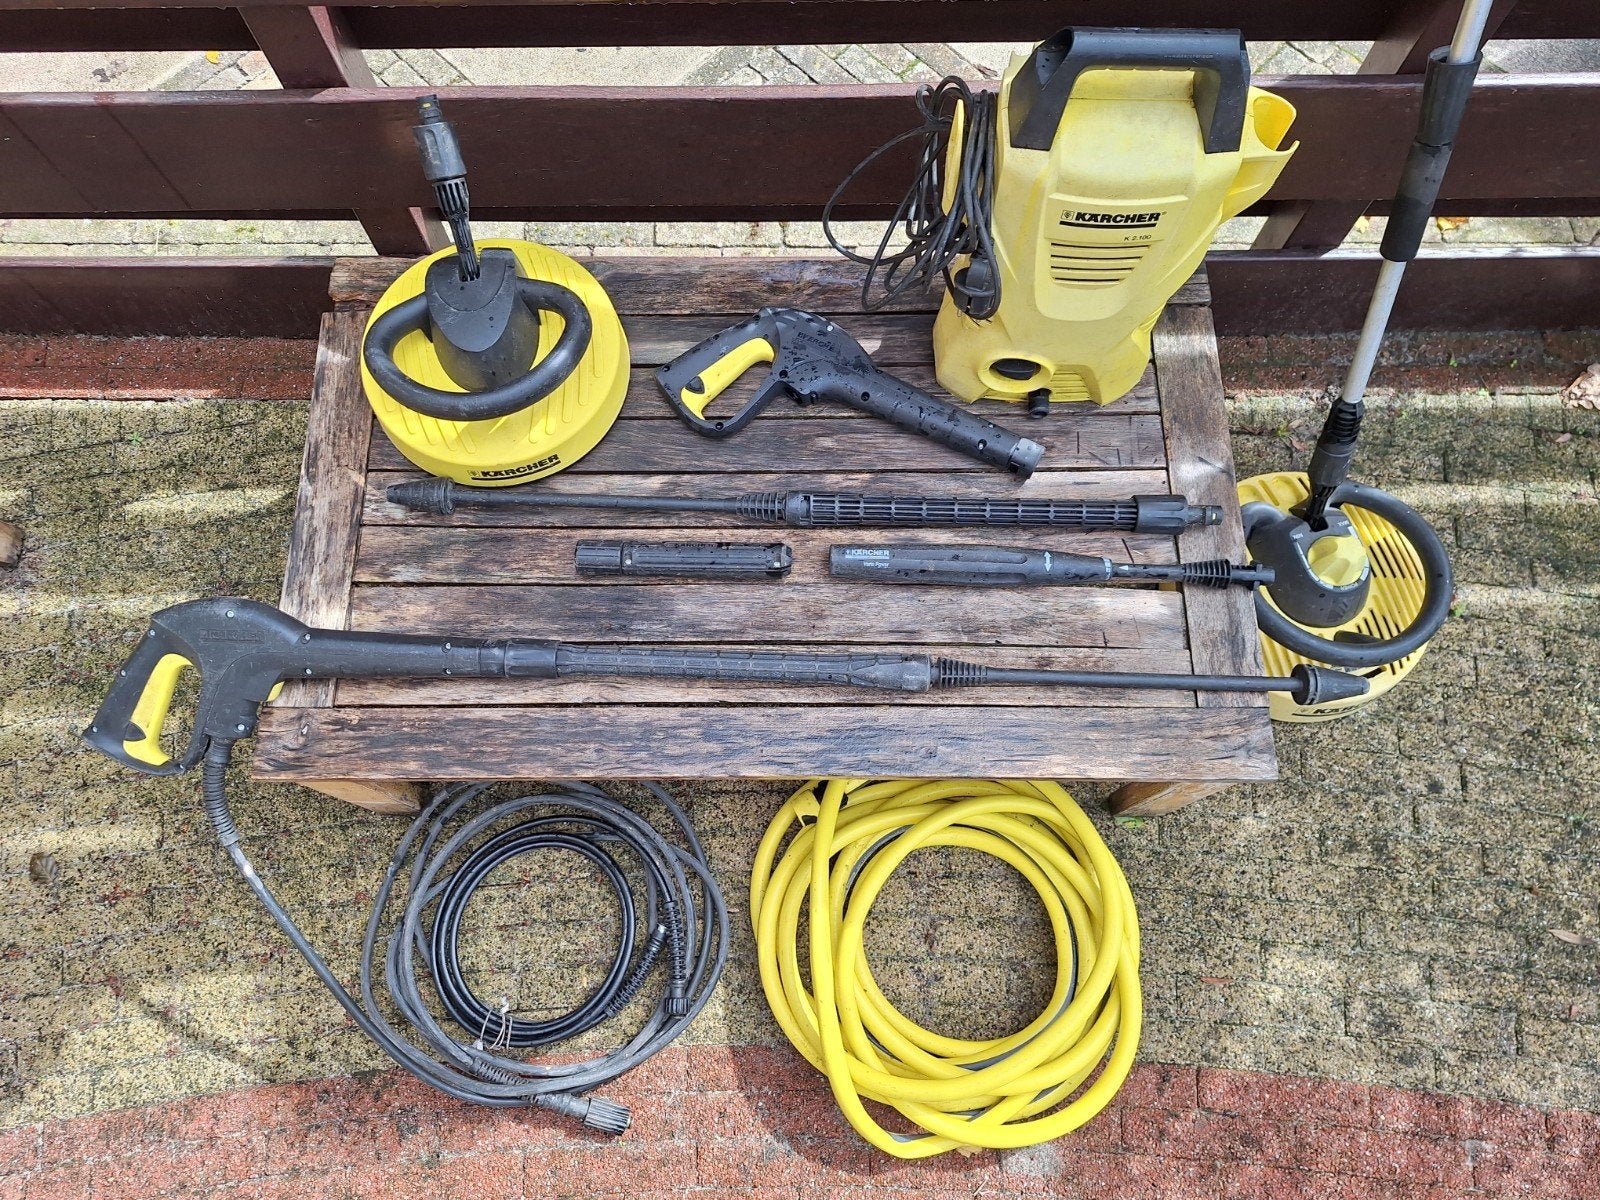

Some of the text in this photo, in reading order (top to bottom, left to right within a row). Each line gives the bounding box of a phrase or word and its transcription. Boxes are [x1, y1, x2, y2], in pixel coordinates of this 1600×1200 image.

[1074, 211, 1161, 224] KÄRCHER
[480, 453, 560, 477] KÄRCHER
[851, 548, 890, 556] KÄRCHER
